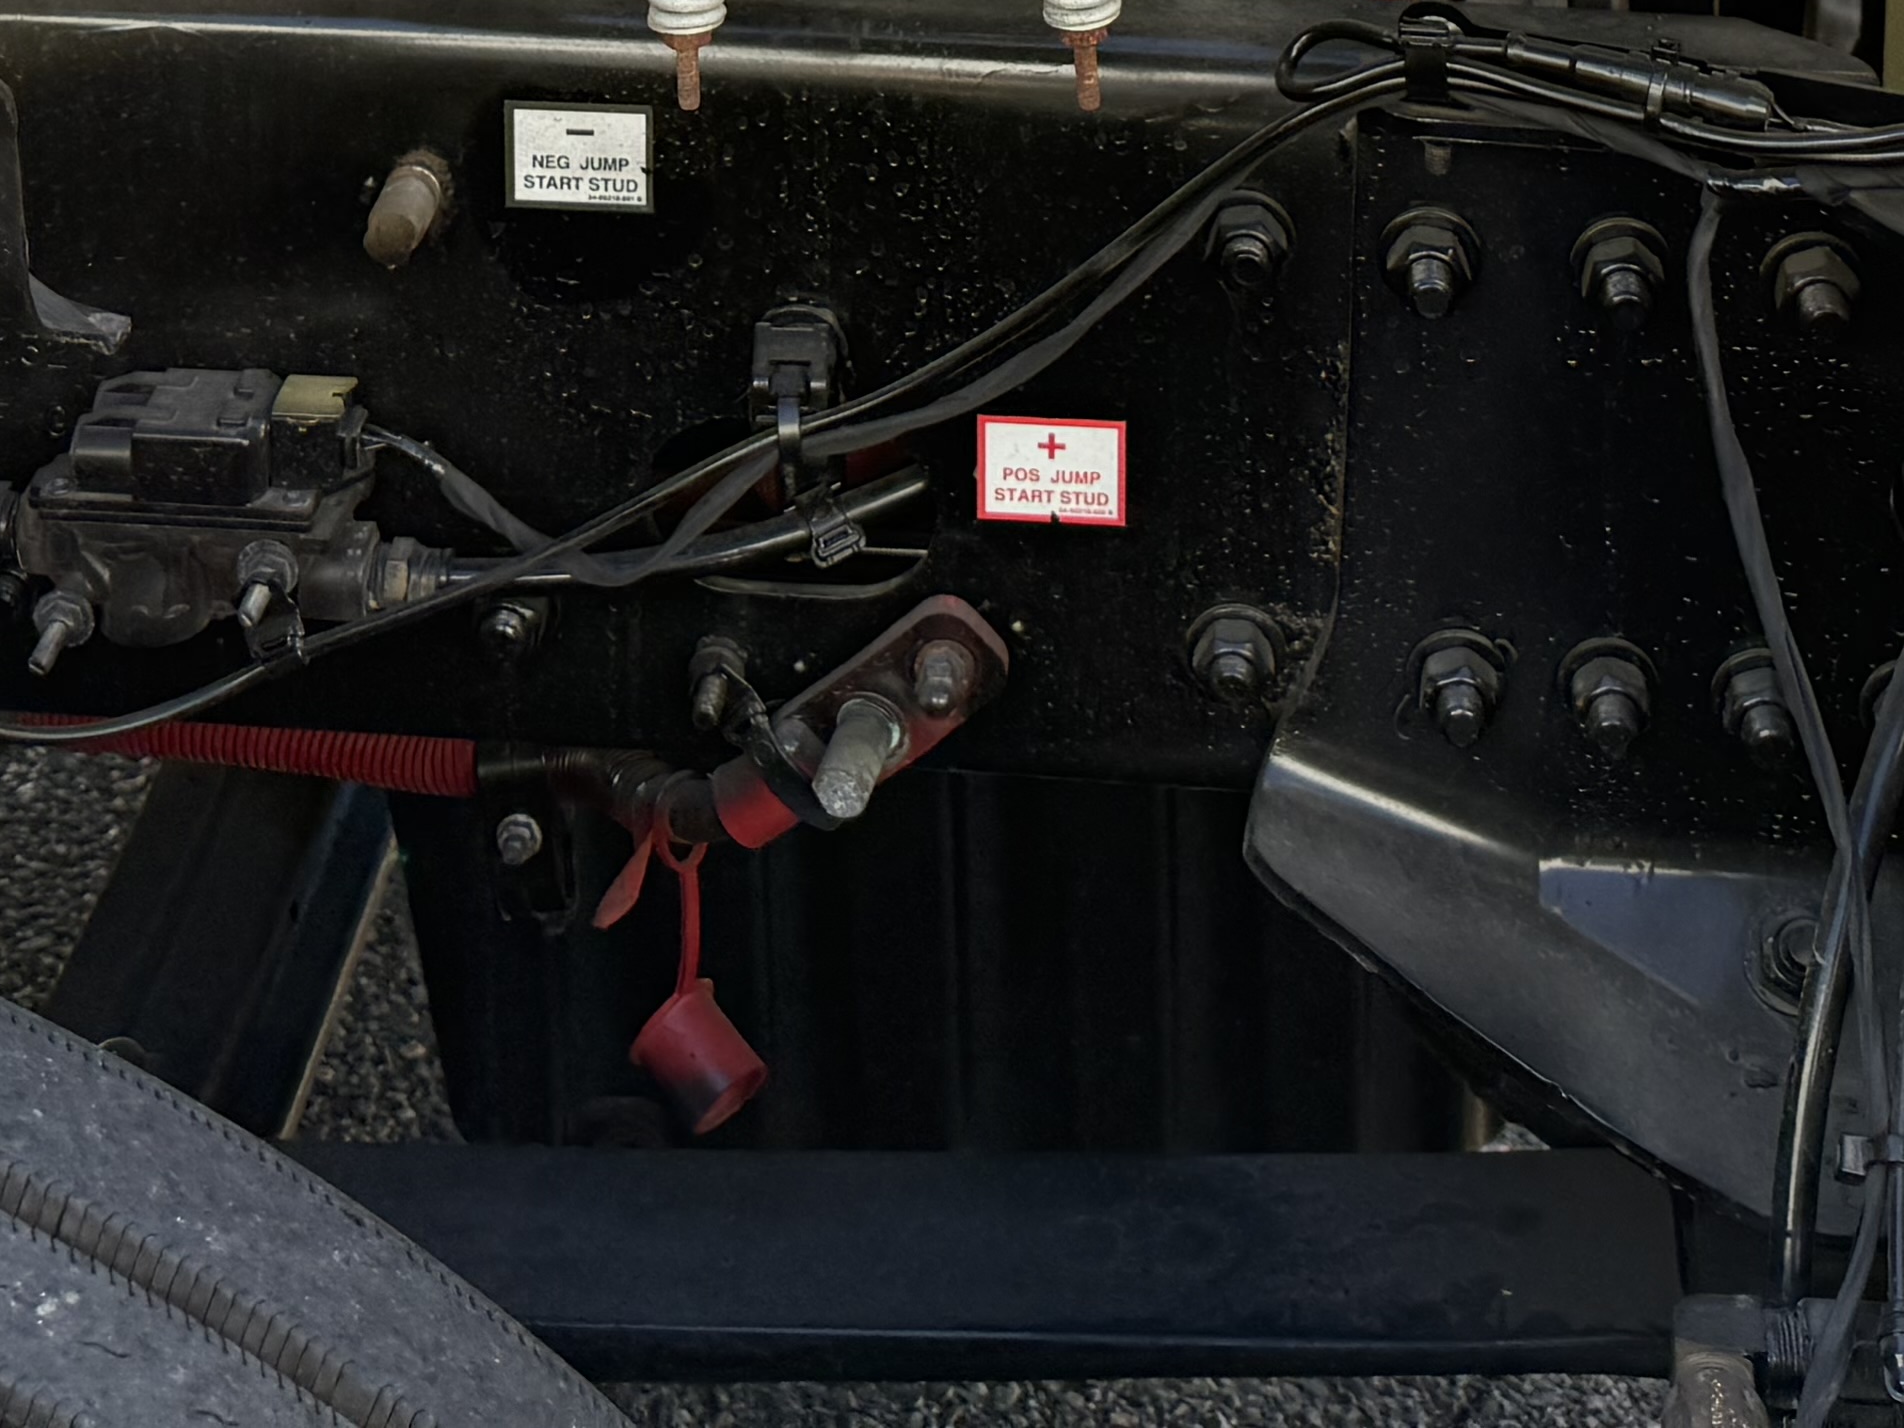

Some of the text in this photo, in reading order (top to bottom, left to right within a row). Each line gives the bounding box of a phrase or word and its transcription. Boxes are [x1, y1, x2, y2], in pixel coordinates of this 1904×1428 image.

[532, 154, 629, 172] NEG JUMP
[523, 174, 639, 193] START STUD
[1002, 467, 1101, 486] POS JUMP
[994, 487, 1110, 506] START STUD
